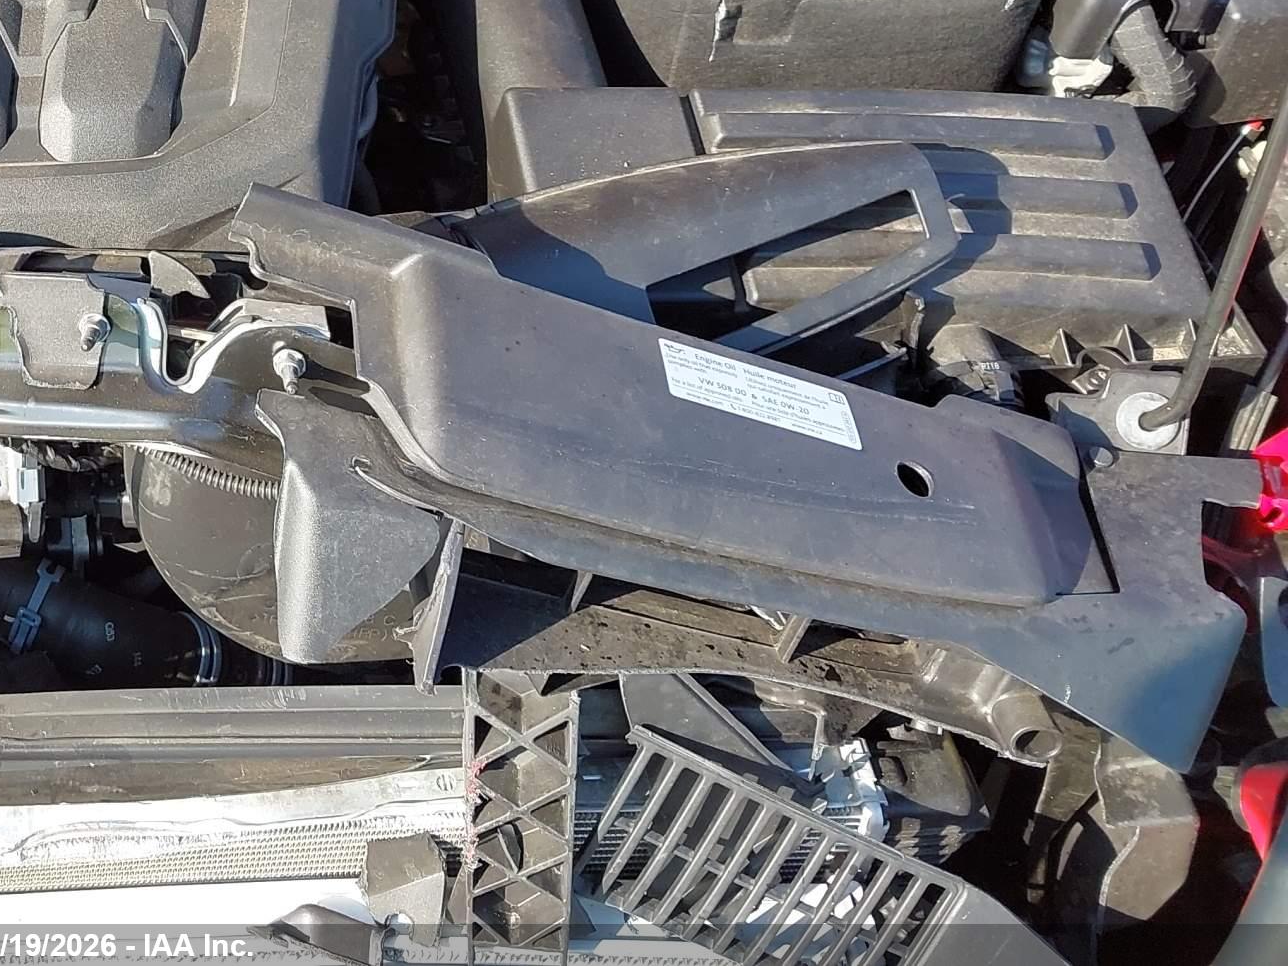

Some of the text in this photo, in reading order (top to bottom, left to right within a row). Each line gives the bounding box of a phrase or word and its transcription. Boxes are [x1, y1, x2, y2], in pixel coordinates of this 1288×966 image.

[694, 353, 737, 372] Engine Oil
[743, 367, 797, 390] Huile moteur
[698, 376, 714, 387] VW
[761, 395, 779, 406] SAE
